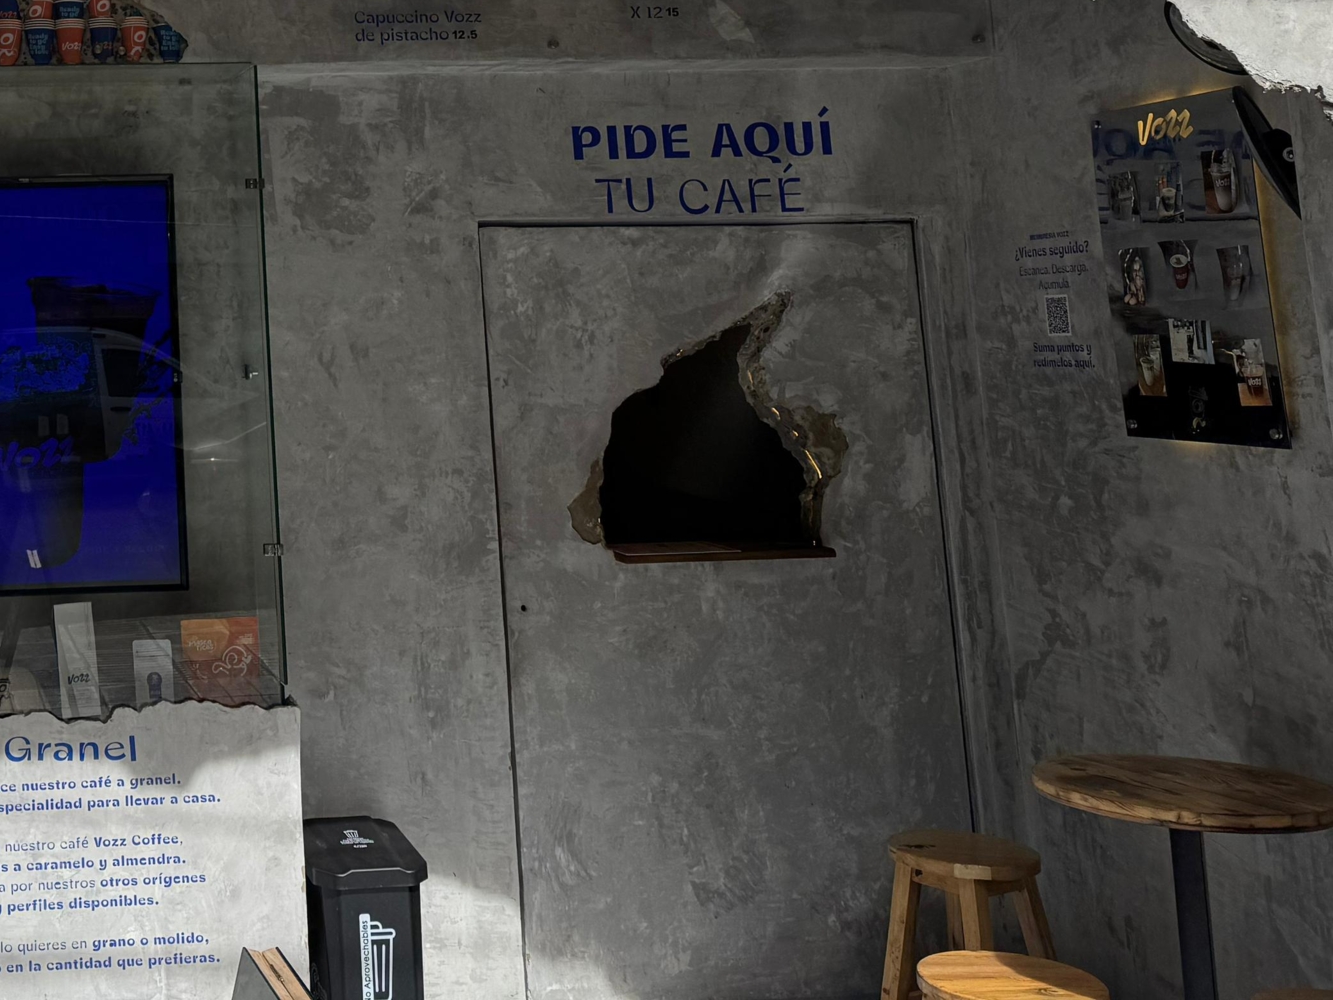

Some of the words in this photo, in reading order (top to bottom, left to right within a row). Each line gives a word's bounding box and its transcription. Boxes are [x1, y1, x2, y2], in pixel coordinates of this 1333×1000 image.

[354, 10, 439, 27] Capuccino
[444, 11, 482, 23] Vozz
[630, 6, 640, 19] X
[647, 6, 663, 18] 12
[666, 8, 679, 17] 15
[355, 29, 374, 42] de
[380, 28, 449, 45] pistacho
[452, 30, 478, 40] 12.5
[571, 124, 690, 160] PIDE
[711, 106, 833, 163] AQUÍ
[595, 177, 654, 214] TU
[679, 163, 804, 214] CAFÉ
[1014, 246, 1047, 261] ¿Vienes
[1049, 240, 1089, 258] seguido?
[1052, 263, 1088, 276] Descarga.
[1033, 342, 1055, 353] Suma
[1056, 341, 1083, 354] puntos
[1086, 344, 1092, 355] y
[4, 735, 137, 762] Granel
[21, 778, 76, 792] nuestro
[80, 775, 112, 789] café
[117, 779, 125, 787] a
[130, 773, 181, 790] granel.
[87, 798, 120, 811] para
[125, 794, 166, 807] llevar
[170, 796, 178, 804] a
[183, 792, 221, 804] casa.
[5, 839, 55, 852] nuestro
[60, 835, 89, 850] café
[93, 836, 127, 848] Vozz
[131, 833, 183, 847] Coffee,
[13, 863, 21, 872] a
[26, 857, 94, 871] caramelo
[99, 859, 107, 870] y
[112, 853, 186, 868] almendra.
[10, 882, 33, 895] por
[38, 878, 96, 892] nuestros
[100, 876, 138, 888] otros
[143, 872, 206, 889] orígenes
[7, 899, 64, 916] perfiles
[68, 894, 159, 911] disponibles.
[0, 941, 13, 953] lo
[17, 938, 67, 955] quieres
[71, 940, 87, 950] en
[92, 937, 135, 951] grano
[140, 936, 149, 946] o
[153, 932, 209, 946] molido,
[6, 963, 24, 973] en
[29, 960, 42, 972] la
[46, 956, 112, 971] cantidad
[117, 956, 143, 970] que
[148, 952, 221, 969] prefieras.
[362, 920, 372, 989] Aprovechables
